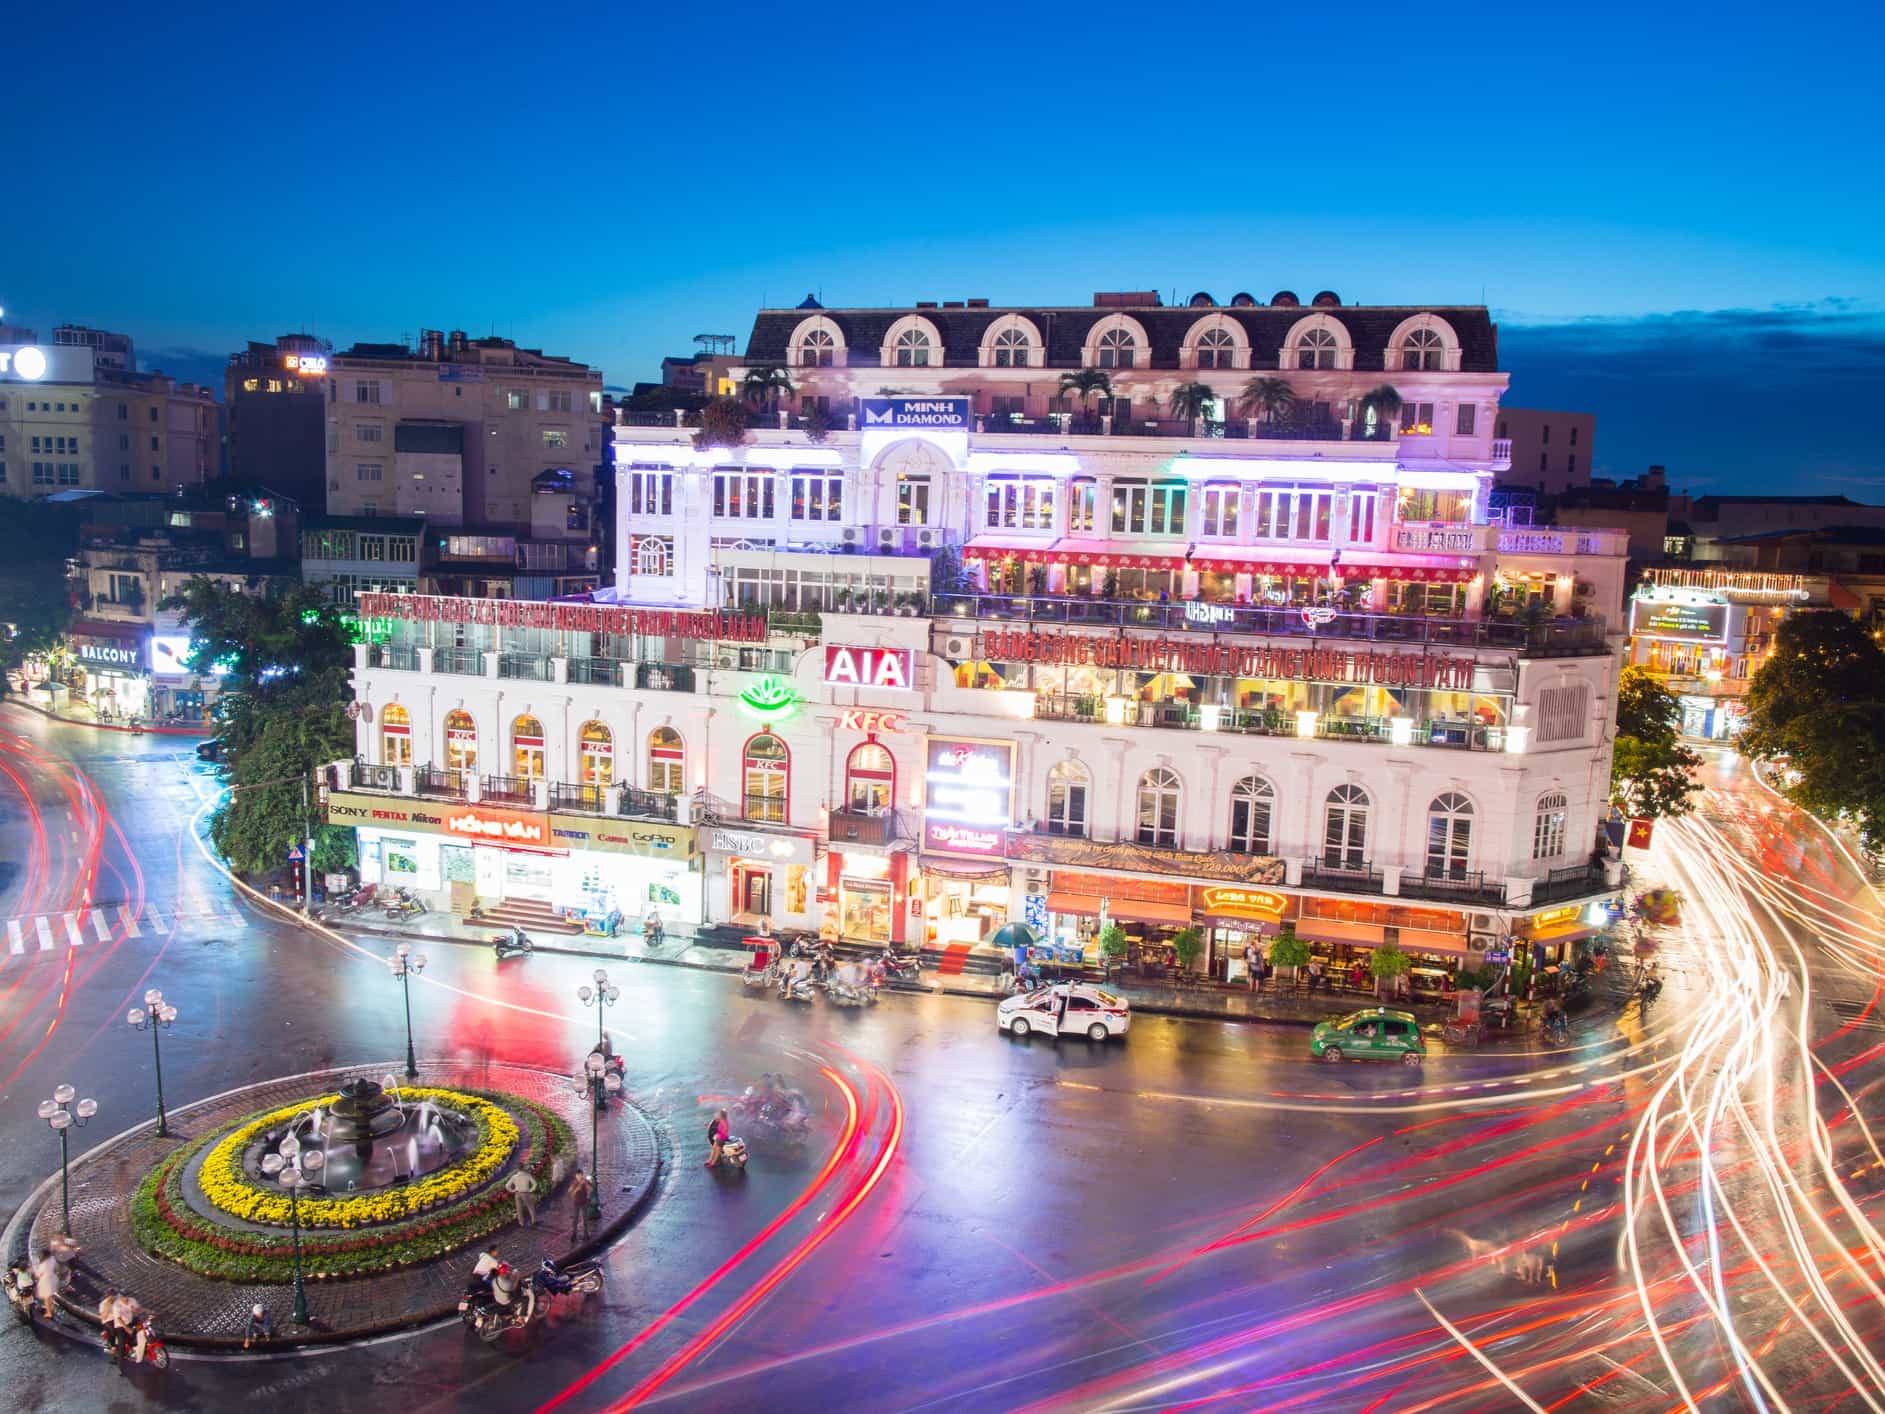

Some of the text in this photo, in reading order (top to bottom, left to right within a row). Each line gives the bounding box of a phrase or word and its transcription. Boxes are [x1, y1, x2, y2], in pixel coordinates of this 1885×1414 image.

[905, 402, 954, 412] MINH
[897, 414, 962, 424] DIAMOND
[82, 646, 137, 664] BALCONY
[828, 648, 906, 688] AIA
[840, 711, 897, 732] KFC
[454, 731, 474, 740] KFC
[587, 742, 609, 753] KFC
[756, 759, 778, 770] KFC
[330, 806, 442, 825] SONY PENTAX Nikon
[632, 832, 676, 844] GoPro
[712, 832, 765, 855] HSBC
